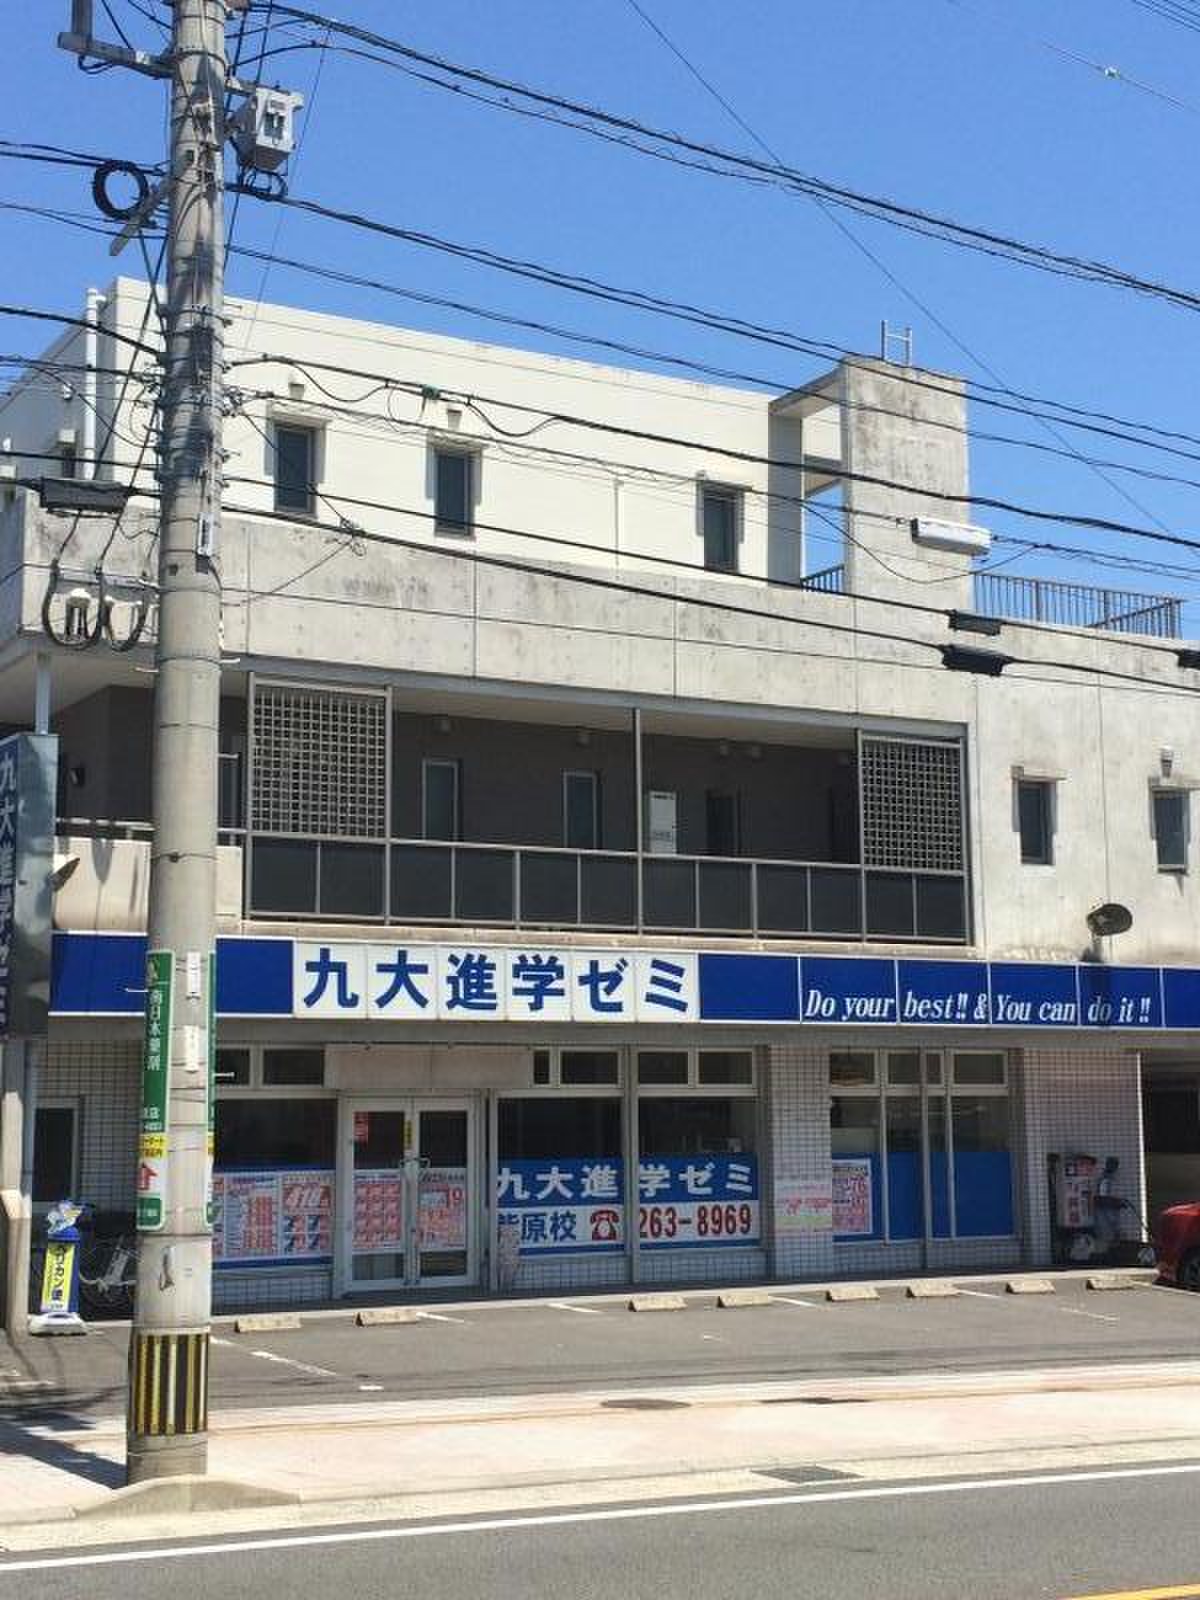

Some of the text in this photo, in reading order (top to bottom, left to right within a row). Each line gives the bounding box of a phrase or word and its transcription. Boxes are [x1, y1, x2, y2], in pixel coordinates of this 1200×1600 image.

[303, 947, 689, 1013] 九大進学ゼミ
[804, 989, 834, 1018] Do
[841, 996, 896, 1021] your
[903, 991, 968, 1020] best!!
[973, 993, 988, 1021] &
[995, 994, 1031, 1021] You
[1038, 1000, 1076, 1022] can
[1087, 995, 1112, 1022] do
[497, 1163, 753, 1201] 九大進学ゼミ
[639, 1204, 752, 1240] 263-8969
